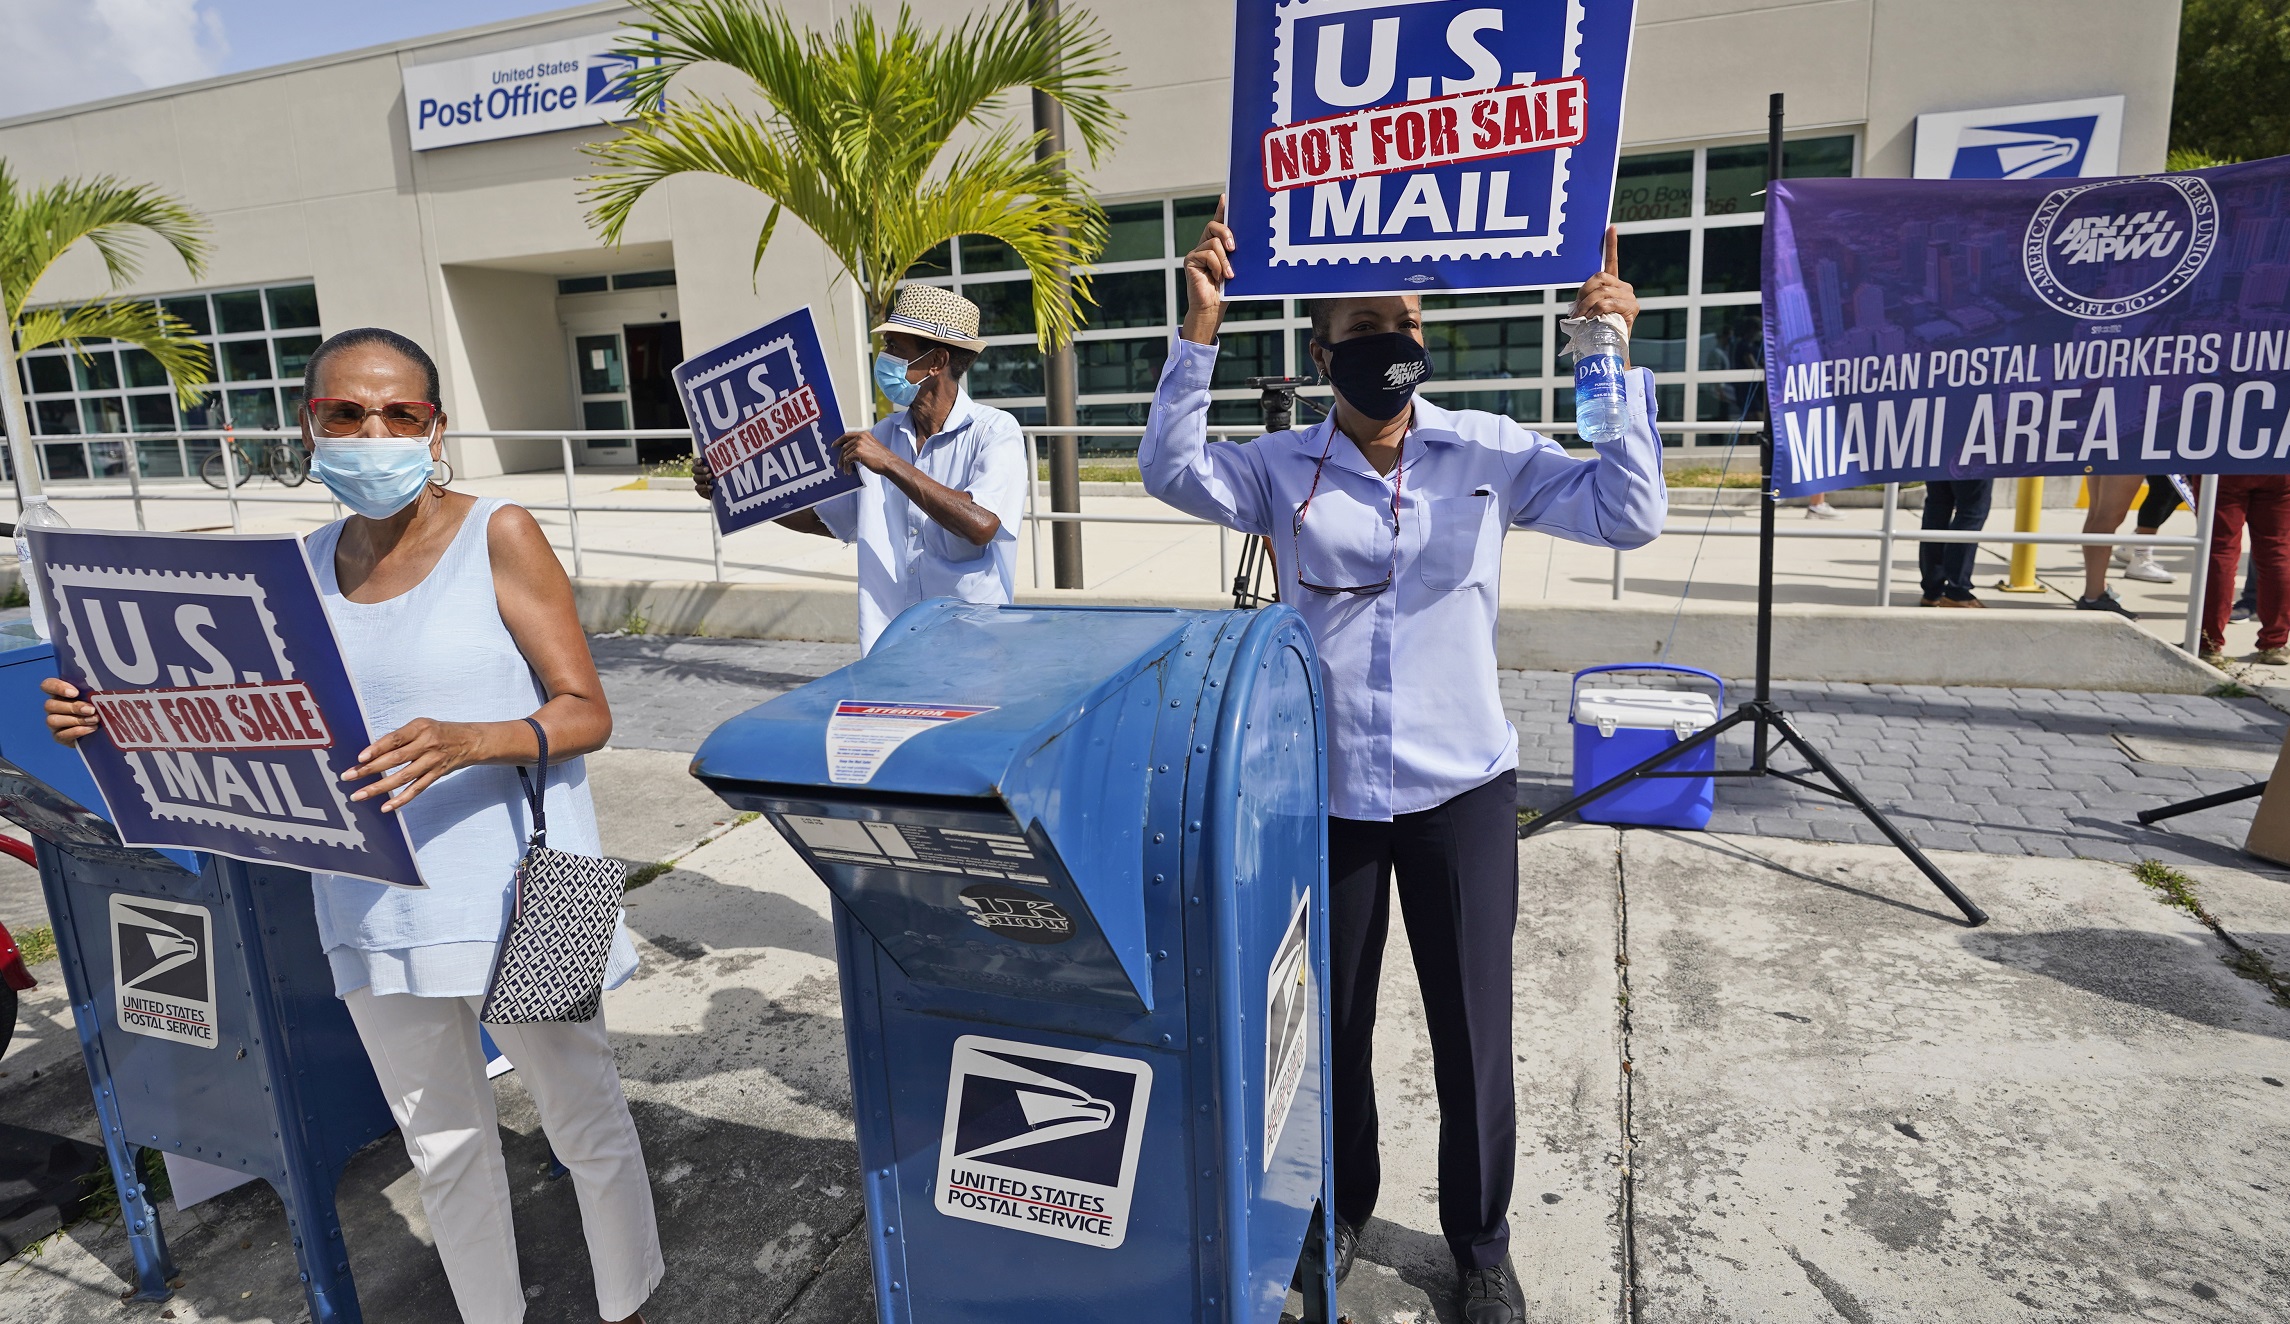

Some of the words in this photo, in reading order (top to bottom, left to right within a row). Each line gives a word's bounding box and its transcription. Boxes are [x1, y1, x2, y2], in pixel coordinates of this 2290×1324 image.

[493, 65, 534, 84] United
[537, 60, 578, 78] States
[1314, 8, 1537, 107] U.S.
[419, 92, 483, 130] Post
[487, 82, 577, 120] Office
[1269, 121, 1358, 183] NOT
[1370, 107, 1461, 166] FOR
[1470, 87, 1579, 150] SALE
[1309, 170, 1529, 239] MAIL
[1619, 187, 1649, 205] PO
[1655, 186, 1711, 202] Boxs
[2028, 200, 2056, 289] AMERICAN
[2176, 218, 2214, 281] UNION
[2072, 296, 2146, 316] AFL-CIO
[702, 363, 789, 431] U.S.
[1783, 353, 1921, 404] AMERICAN
[1928, 344, 2041, 388] POSTAL
[2054, 332, 2221, 381] WORKERS
[707, 436, 741, 474] NOT
[739, 418, 774, 455] FOR
[770, 390, 817, 435] SALE
[1784, 396, 1947, 484] MIAMI
[1959, 387, 2120, 466] AREA
[731, 440, 818, 498] MAIL
[82, 598, 263, 687] U.S.
[99, 698, 168, 746] NOT
[161, 696, 238, 744] FOR
[226, 690, 326, 743] SALE
[861, 707, 946, 717] ATTENTION
[151, 750, 328, 822] MAIL
[122, 995, 164, 1014] UNITED
[166, 1004, 205, 1022] STATES
[124, 1011, 165, 1030] POSTAL
[167, 1020, 211, 1040] SERVICE
[948, 1189, 1022, 1219] POSTAL
[1027, 1206, 1112, 1237] SERVICE
[950, 1168, 1027, 1197] UNITED
[1031, 1185, 1105, 1213] STATES
